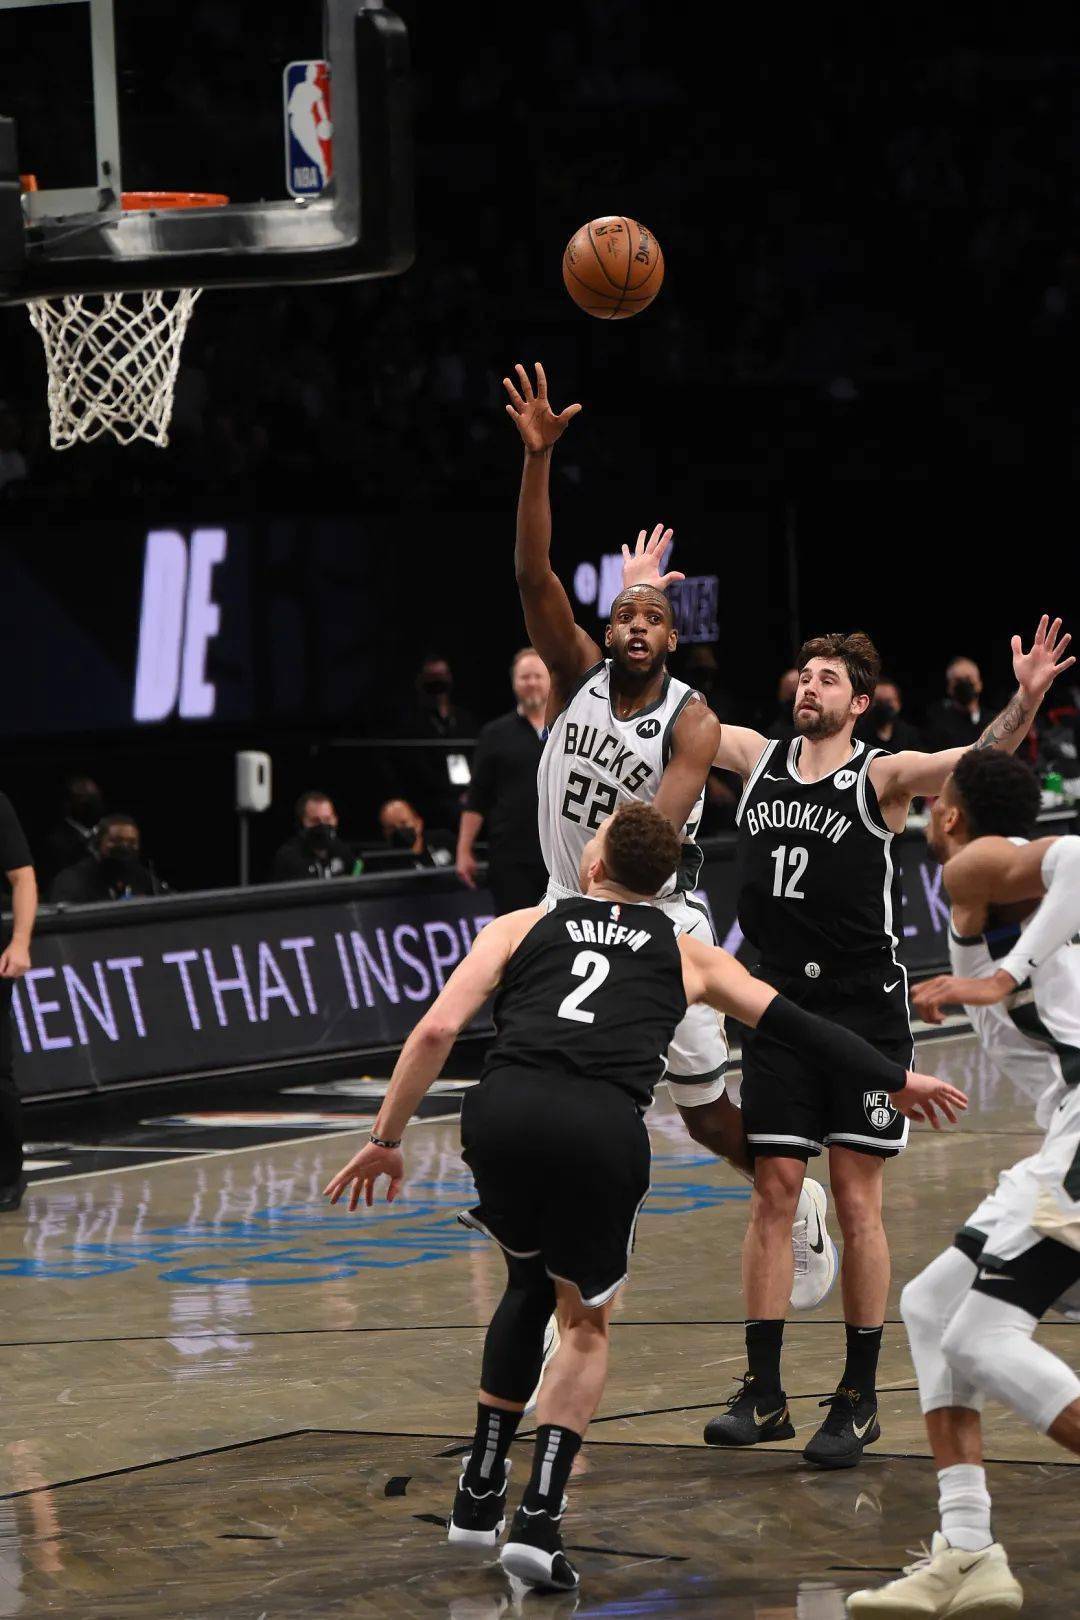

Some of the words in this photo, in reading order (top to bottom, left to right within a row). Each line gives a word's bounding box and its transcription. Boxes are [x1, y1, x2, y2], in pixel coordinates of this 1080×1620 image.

[294, 166, 319, 188] NBA
[564, 722, 653, 793] BUCKS
[562, 770, 618, 830] 22
[746, 799, 852, 843] BROOKLYN
[771, 845, 809, 899] 12
[565, 919, 651, 952] GRIFFIN
[11, 956, 147, 1053] ENT
[162, 936, 318, 1031] THAT
[557, 949, 610, 1024] 2
[865, 1092, 897, 1111] NET
